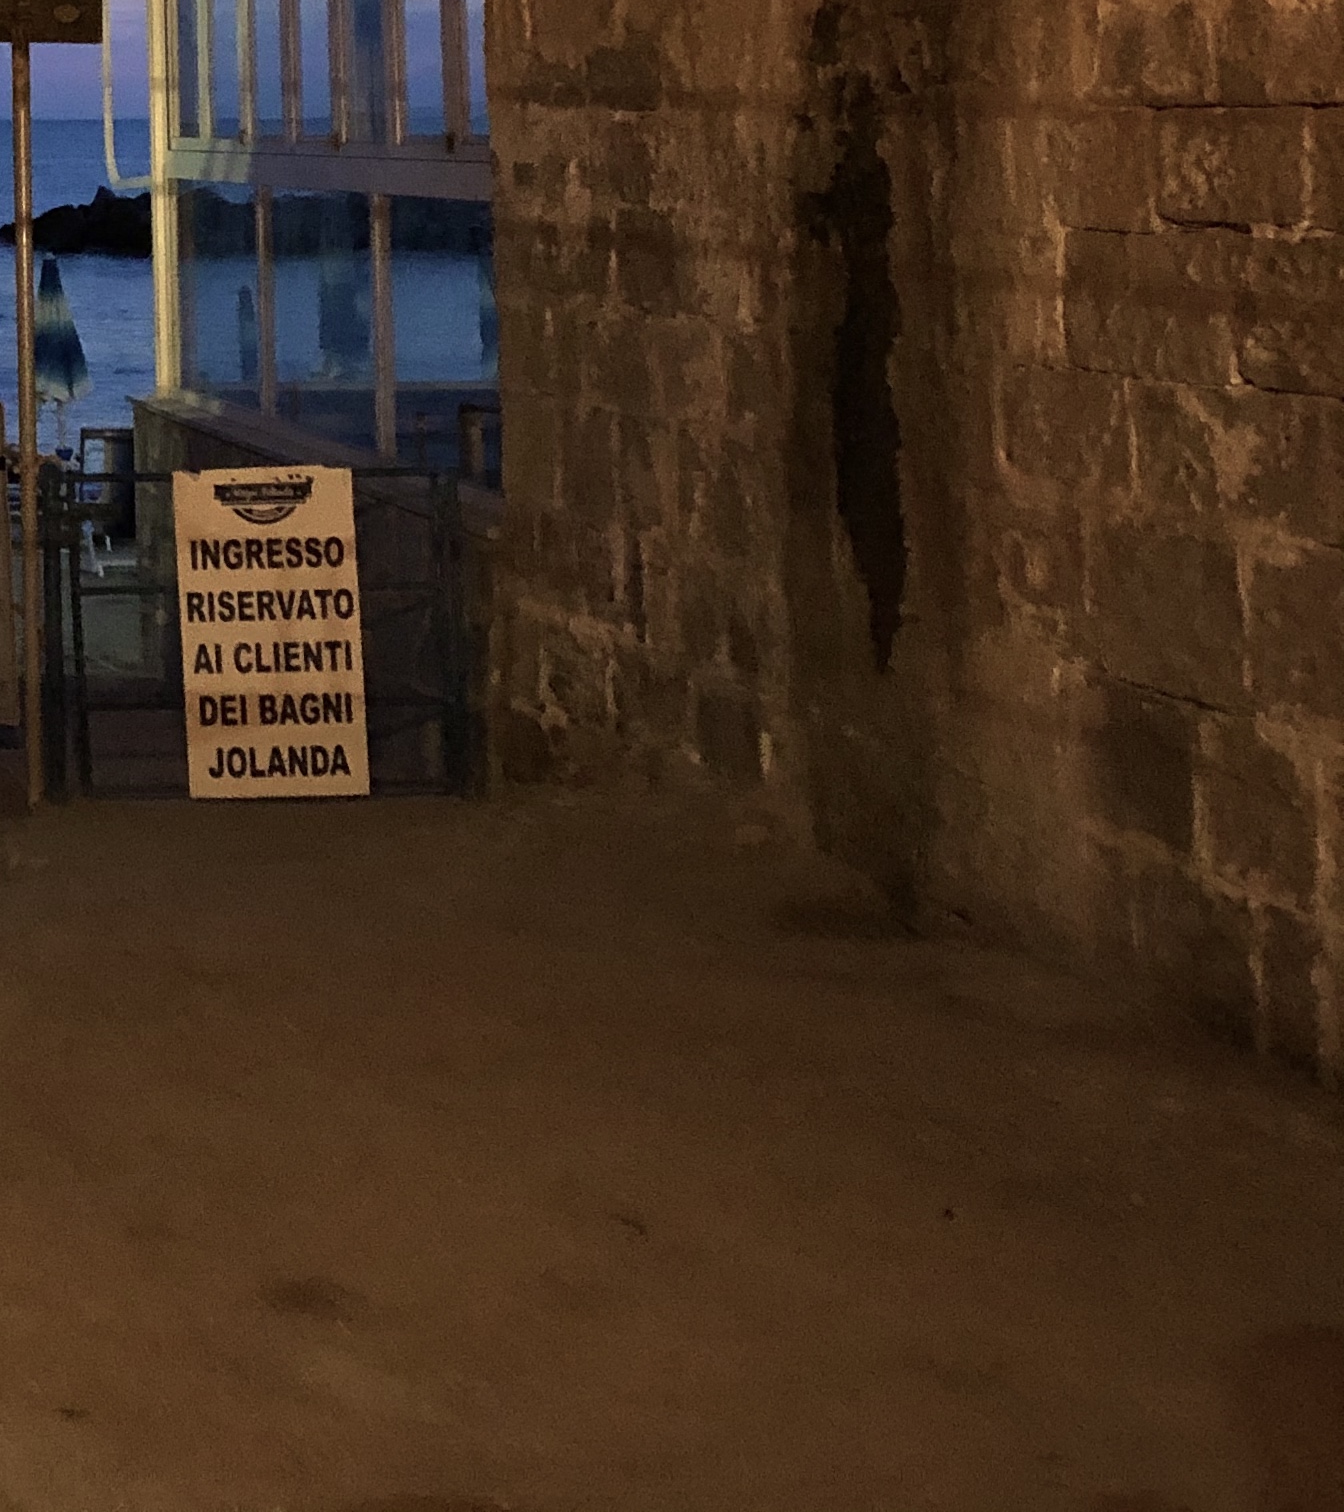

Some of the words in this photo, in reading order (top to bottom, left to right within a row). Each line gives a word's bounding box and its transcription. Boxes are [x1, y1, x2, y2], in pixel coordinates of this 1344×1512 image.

[190, 537, 344, 570] INGRESSO
[186, 589, 354, 623] RISERVATO
[193, 643, 223, 675] AI
[233, 641, 352, 673] CLIENTI
[199, 695, 248, 727] DEI
[258, 692, 353, 726] BAGNI
[208, 745, 351, 779] JOLANDA
